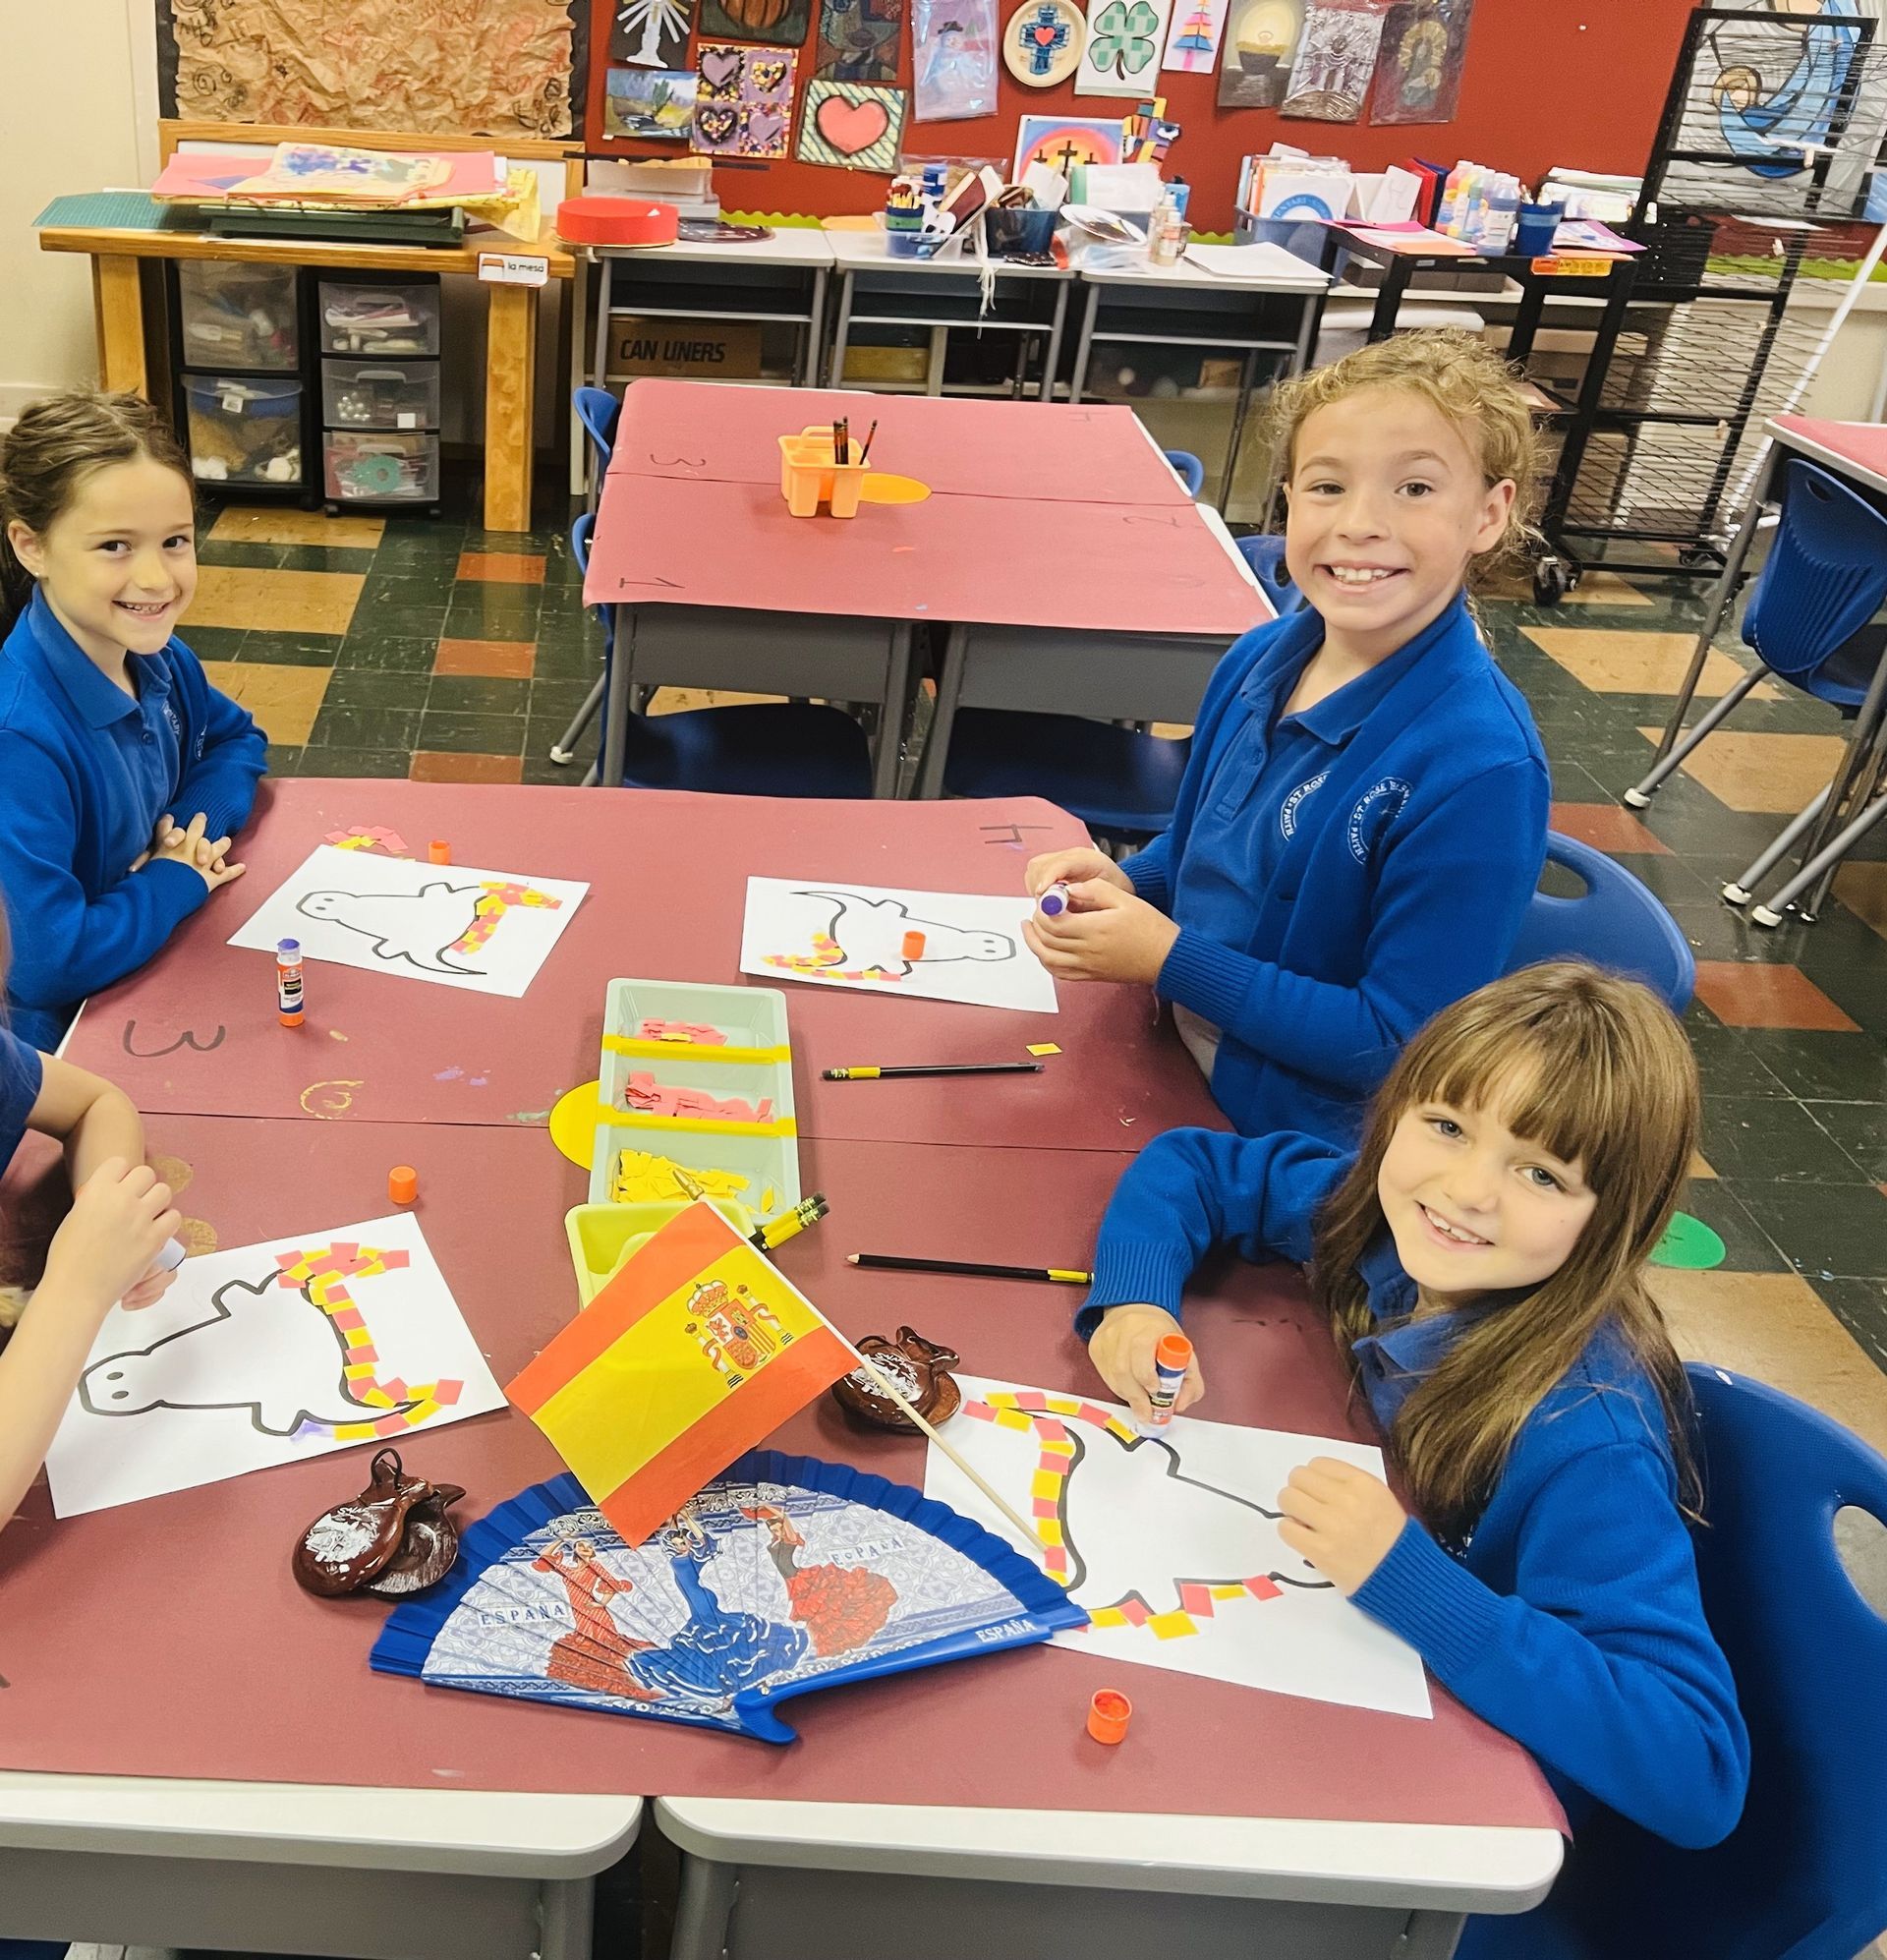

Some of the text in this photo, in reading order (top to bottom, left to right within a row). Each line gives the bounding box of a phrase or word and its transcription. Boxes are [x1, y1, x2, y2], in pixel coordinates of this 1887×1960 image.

[507, 261, 544, 273] la mesa
[620, 339, 726, 364] CAN LINERS
[1288, 790, 1302, 804] ST
[1353, 805, 1364, 820] ST
[1363, 783, 1387, 804] ROSE
[979, 824, 1054, 844] 4
[123, 1019, 226, 1058] 3
[482, 1601, 565, 1626] ESPAÑA
[974, 1618, 1039, 1643] ESPAÑA
